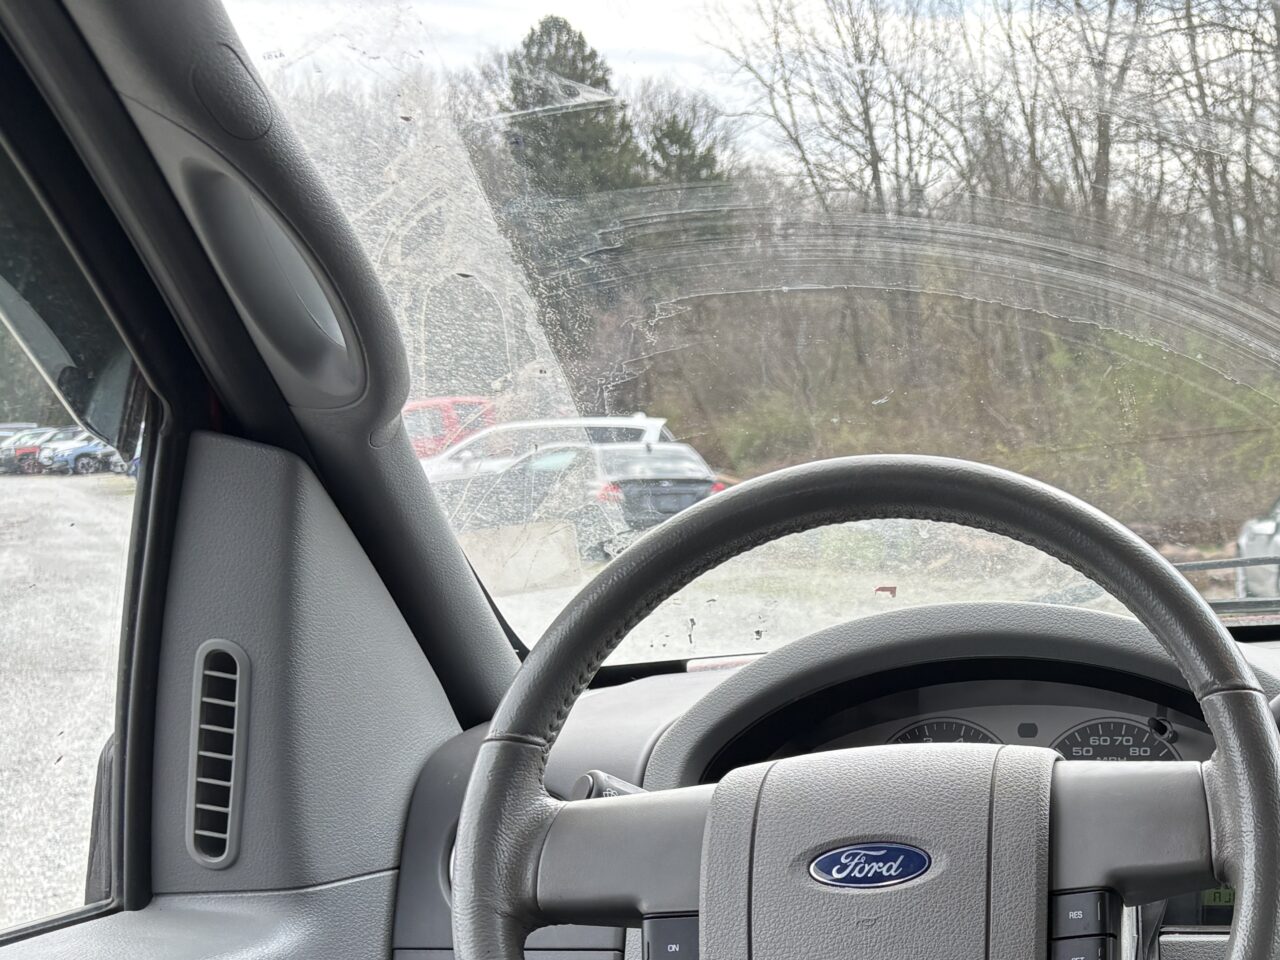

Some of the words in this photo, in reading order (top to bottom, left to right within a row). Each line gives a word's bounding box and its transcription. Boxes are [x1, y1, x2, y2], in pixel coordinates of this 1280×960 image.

[1089, 736, 1110, 745] 60
[1113, 736, 1133, 745] 70
[1072, 747, 1093, 756] 50
[1129, 747, 1151, 756] 80
[832, 849, 904, 879] Ford
[1068, 910, 1083, 920] RES
[667, 944, 680, 953] ON
